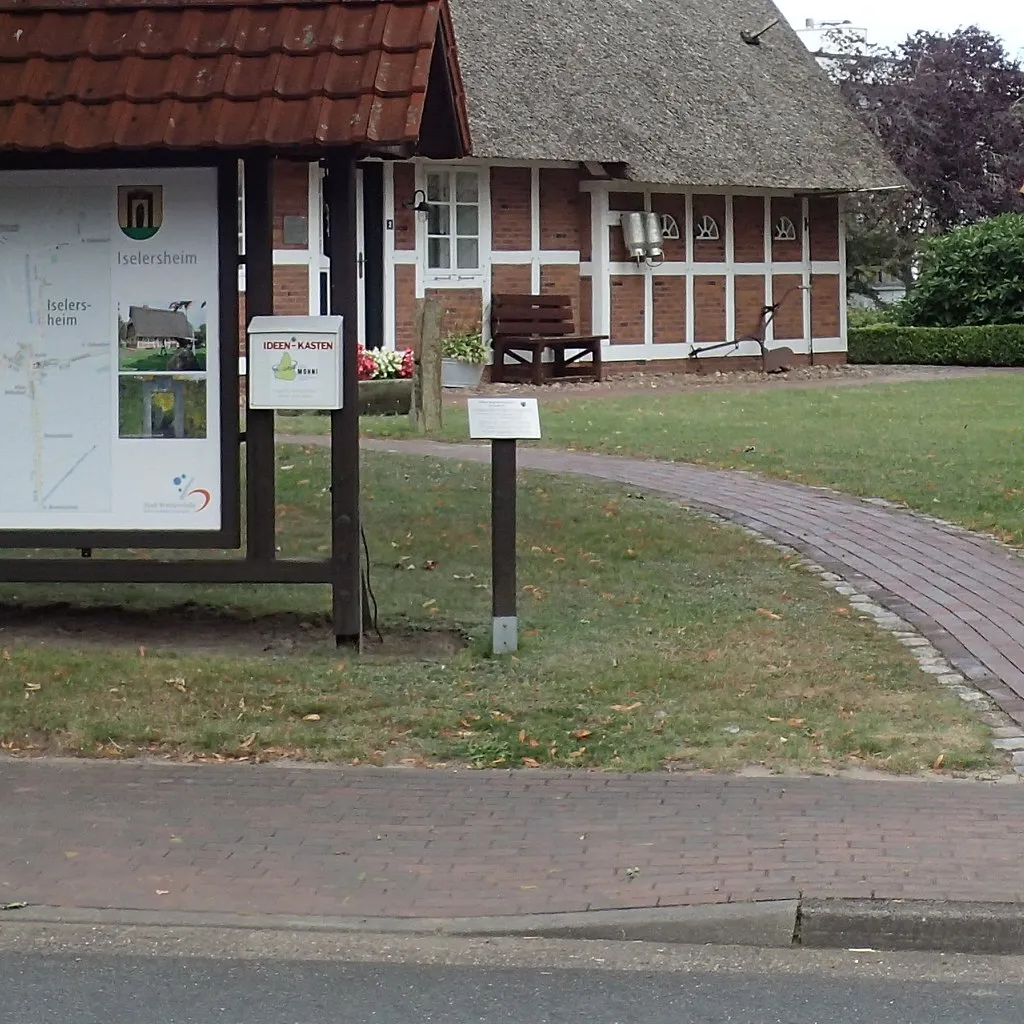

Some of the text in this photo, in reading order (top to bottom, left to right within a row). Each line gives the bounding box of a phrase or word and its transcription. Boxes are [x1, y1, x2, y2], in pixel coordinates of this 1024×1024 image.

[117, 250, 198, 265] Iselersheim
[47, 298, 92, 311] Iselers-
[47, 314, 78, 326] heim
